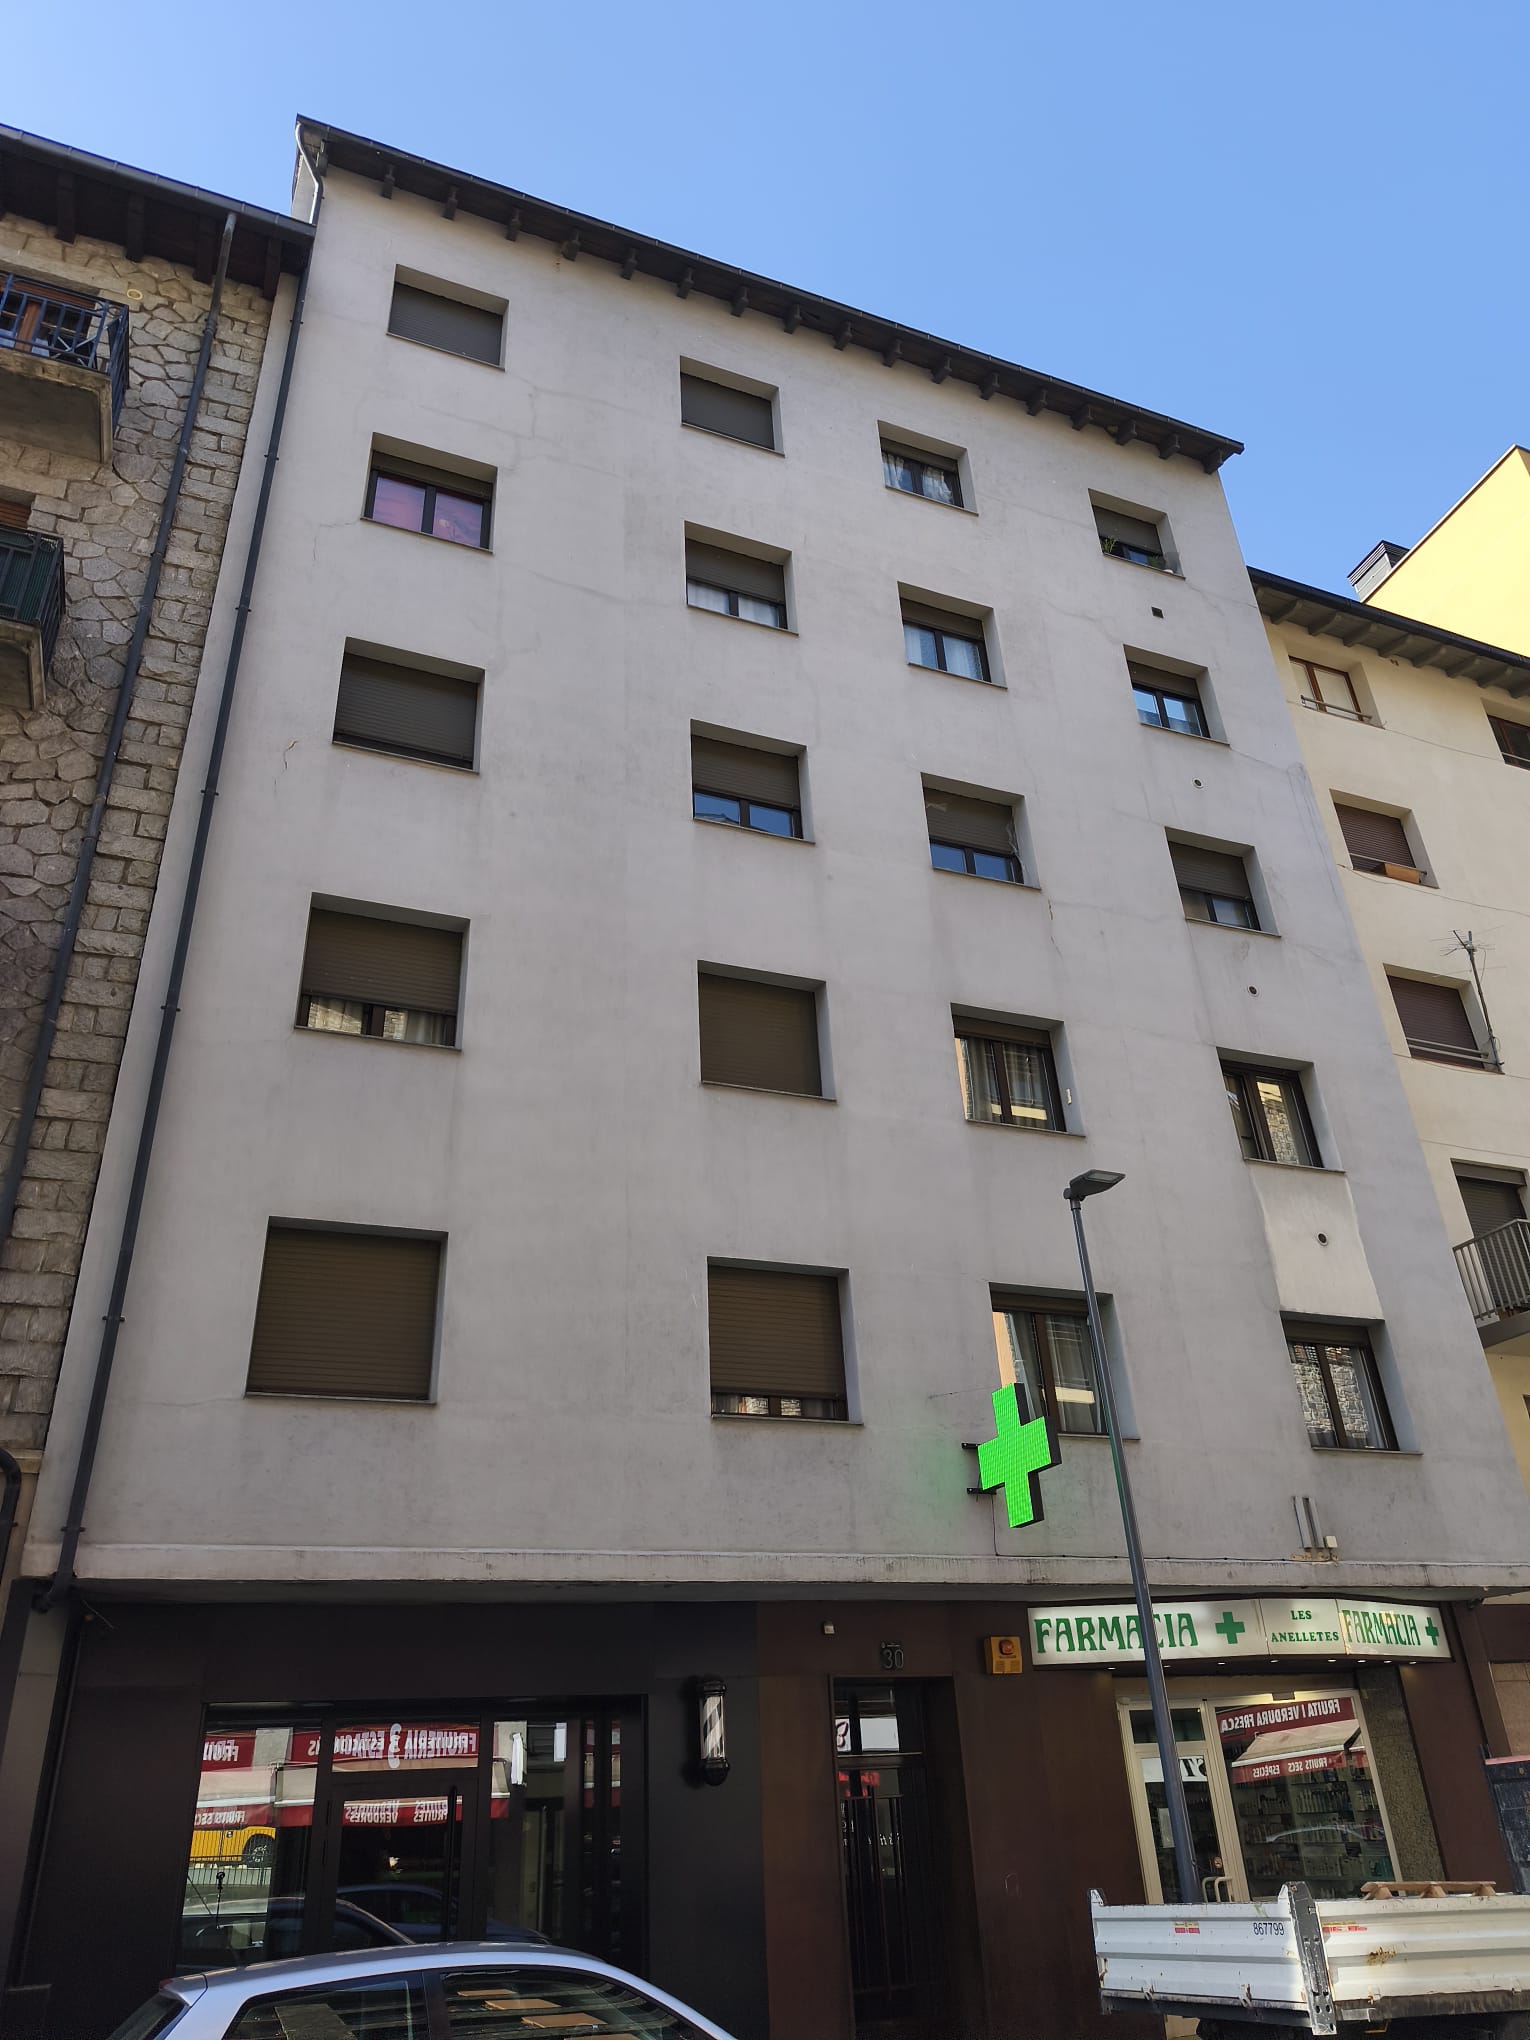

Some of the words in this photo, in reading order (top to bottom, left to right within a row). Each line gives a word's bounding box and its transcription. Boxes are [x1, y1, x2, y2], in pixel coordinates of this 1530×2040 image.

[1290, 1610, 1312, 1621] LES
[1341, 1609, 1422, 1646] FARMACIA
[1271, 1631, 1340, 1643] ANELLETES
[883, 1649, 904, 1669] 30
[1253, 1922, 1285, 1936] 867799
